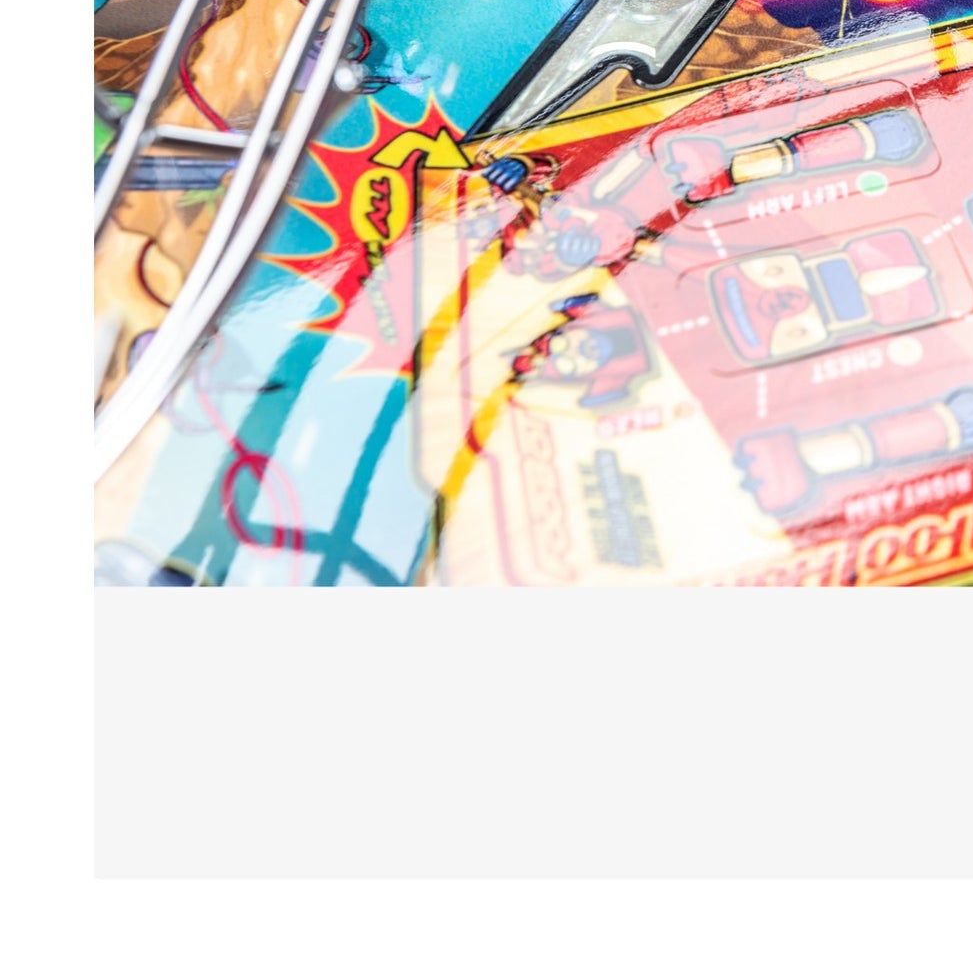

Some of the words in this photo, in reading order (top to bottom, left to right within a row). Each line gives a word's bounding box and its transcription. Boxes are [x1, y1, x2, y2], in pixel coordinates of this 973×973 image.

[747, 192, 795, 219] ARM
[801, 180, 848, 208] LEFT
[811, 347, 884, 385] CHEST
[844, 488, 899, 522] ARM
[903, 469, 971, 509] RIGHT
